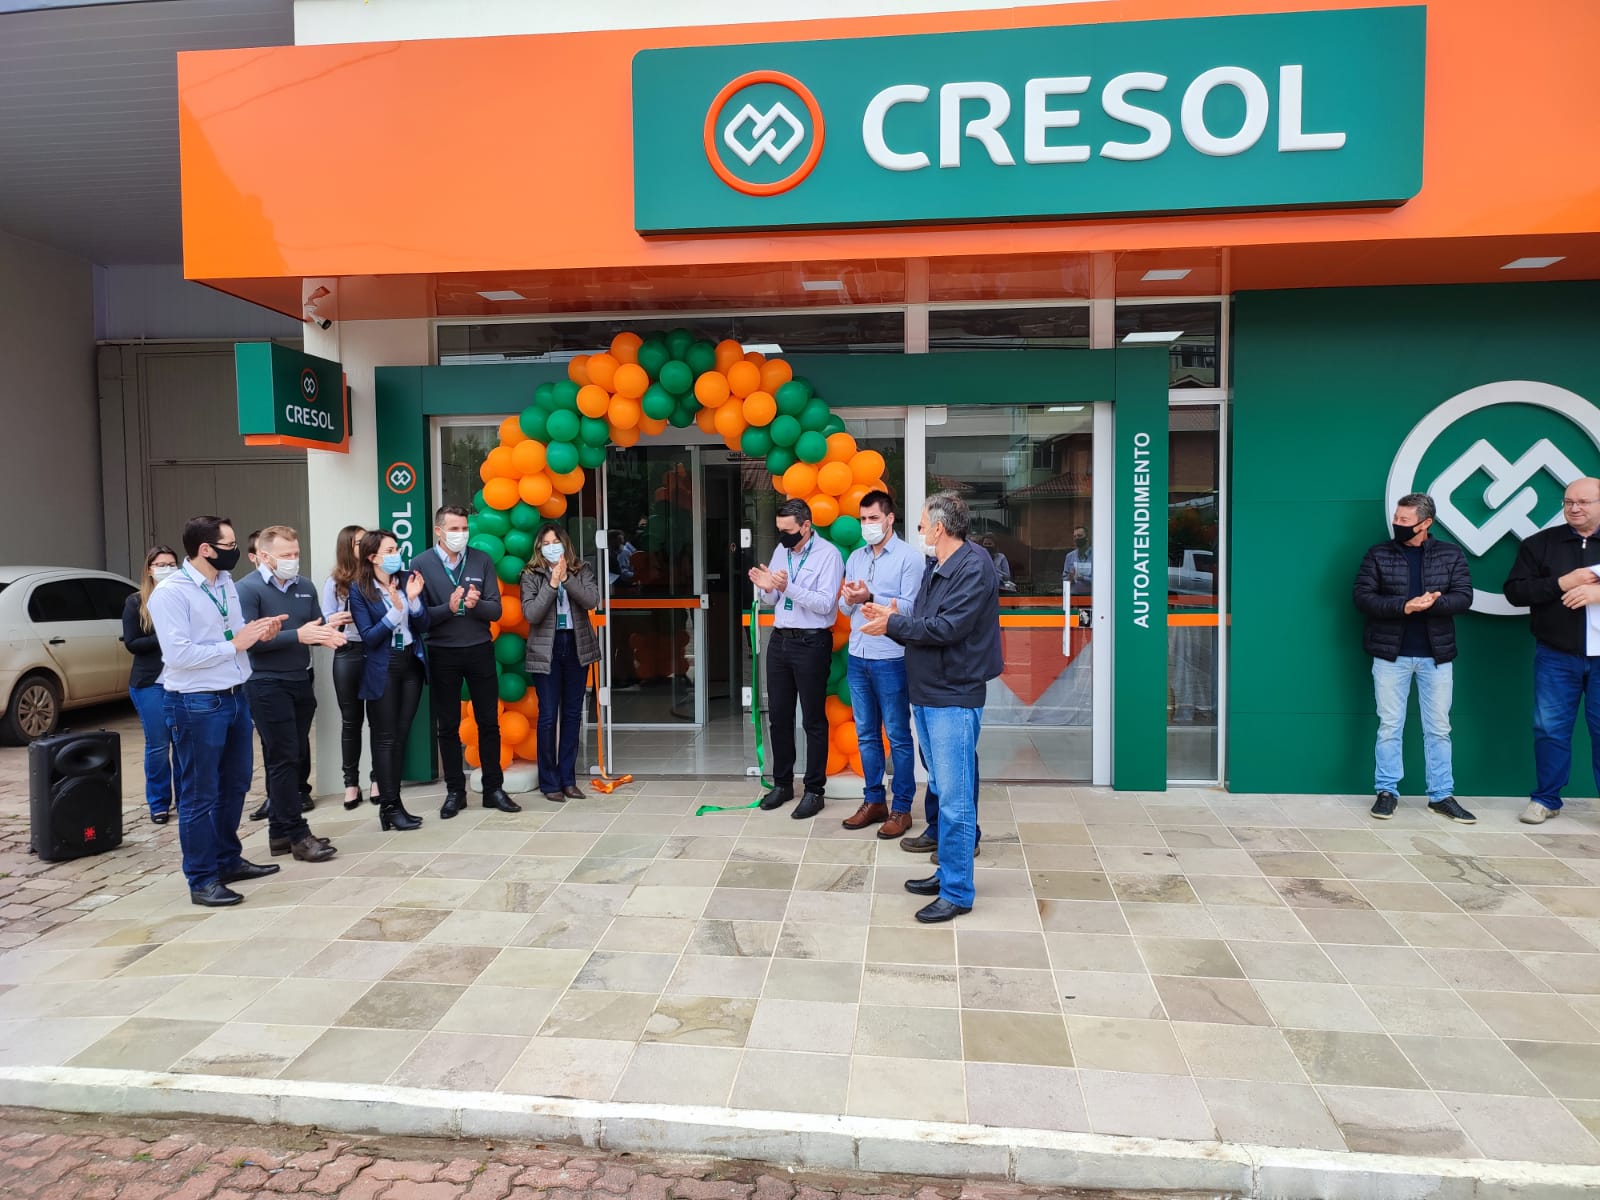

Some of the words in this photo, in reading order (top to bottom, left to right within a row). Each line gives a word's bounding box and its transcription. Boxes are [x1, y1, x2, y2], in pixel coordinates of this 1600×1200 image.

[862, 64, 1346, 171] CRESOL
[285, 404, 335, 430] CRESOL
[1133, 432, 1150, 628] AUTOATENDIMENTO
